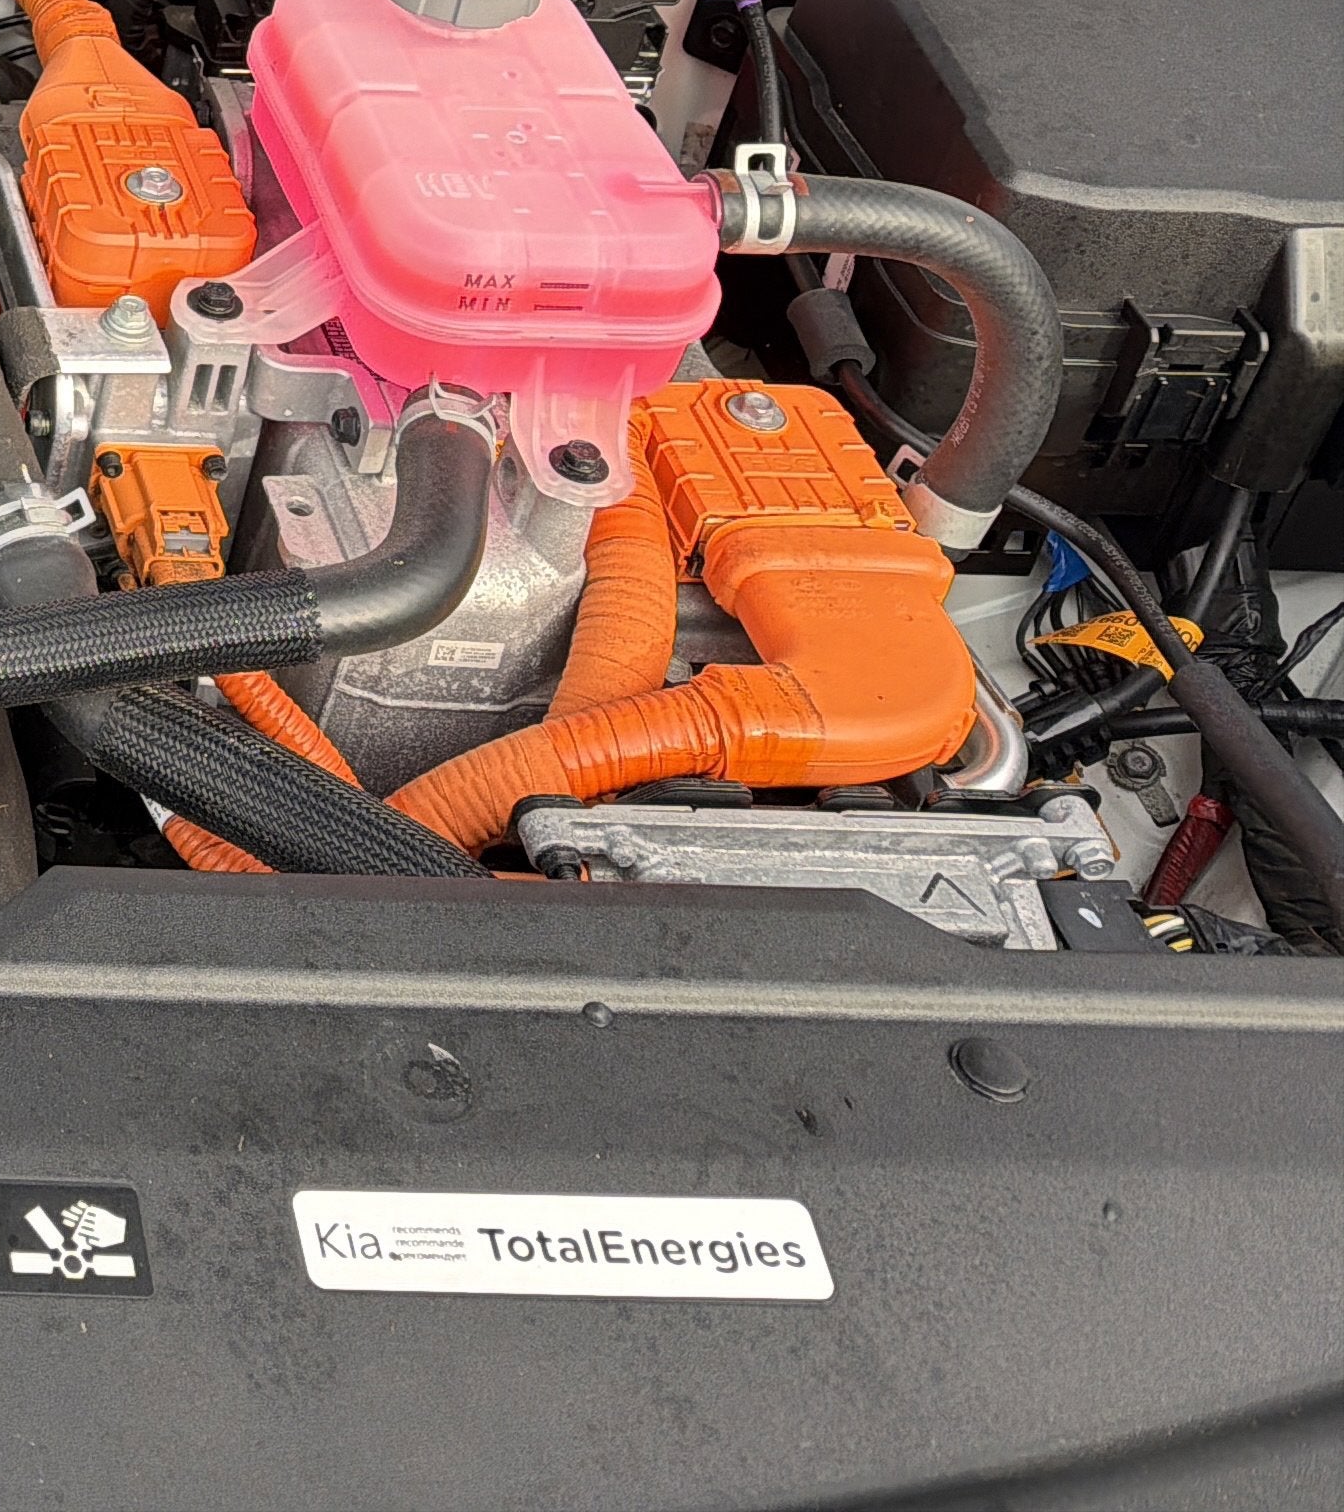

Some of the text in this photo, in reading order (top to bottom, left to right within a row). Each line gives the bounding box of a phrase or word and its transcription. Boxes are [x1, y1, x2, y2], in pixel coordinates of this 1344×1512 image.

[463, 273, 517, 290] MAX
[458, 296, 511, 311] MIN
[392, 1226, 461, 1236] recommends
[313, 1221, 808, 1273] Kia TotalEnergies
